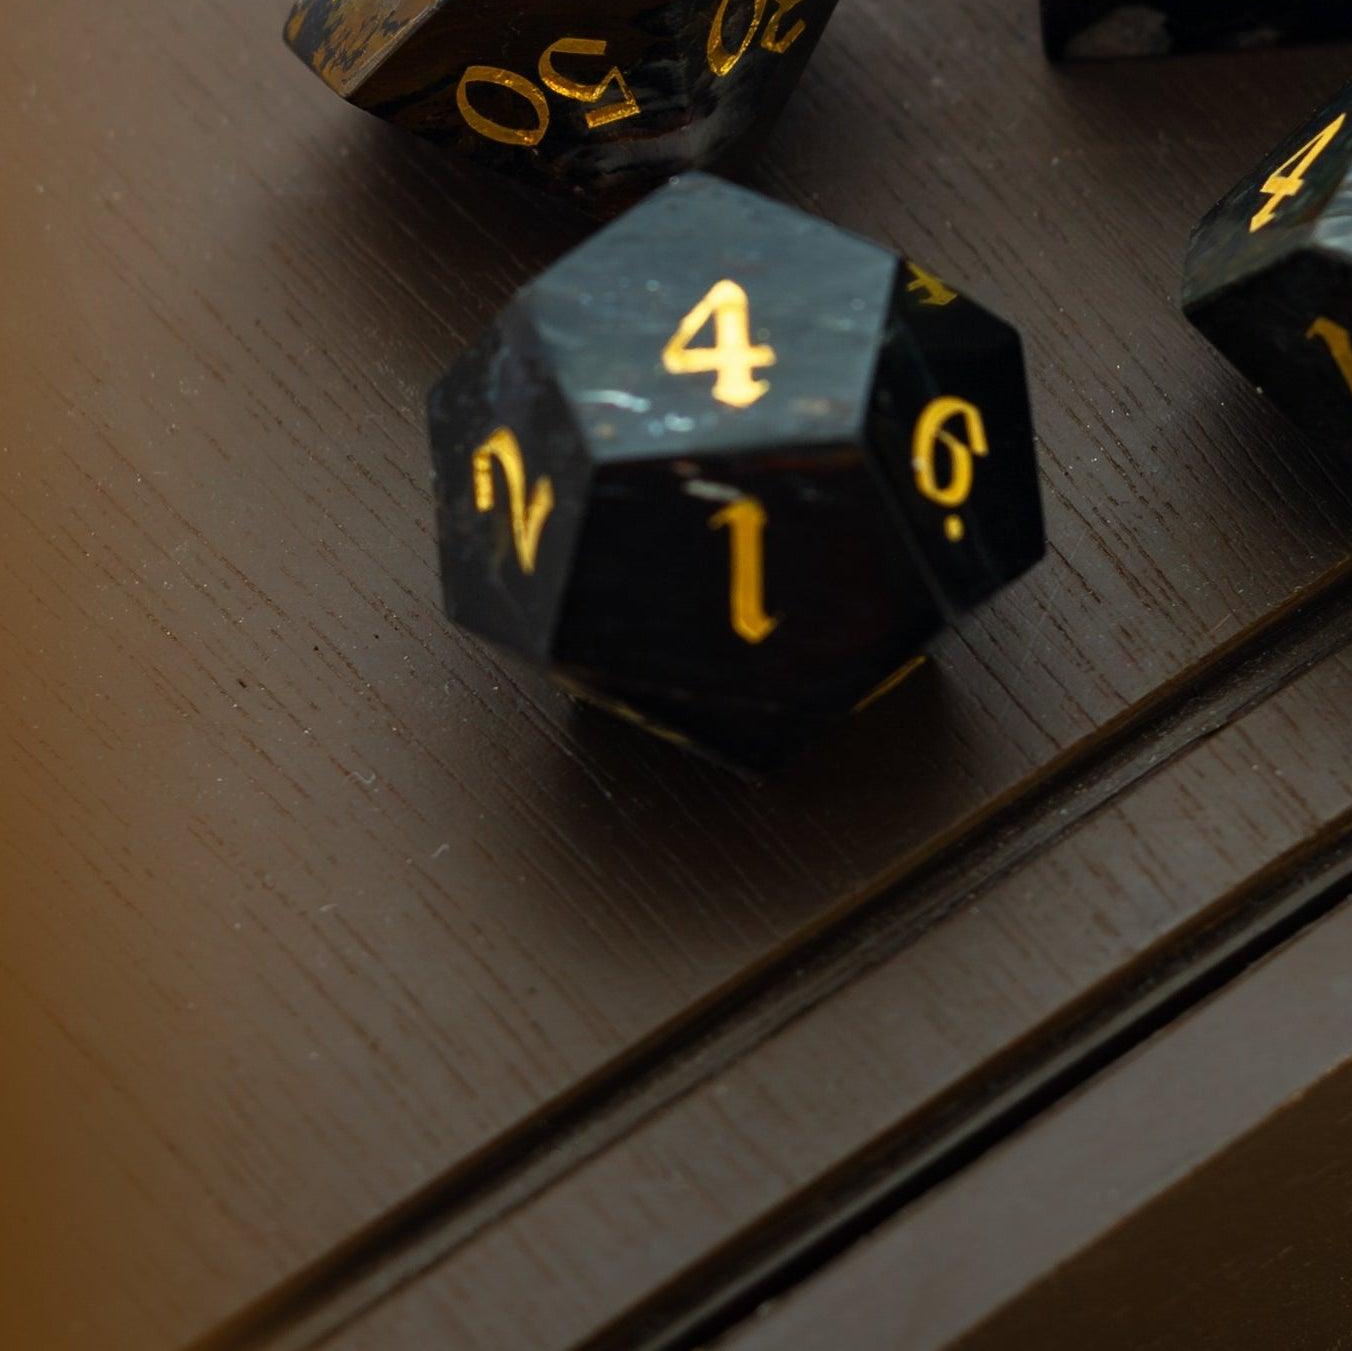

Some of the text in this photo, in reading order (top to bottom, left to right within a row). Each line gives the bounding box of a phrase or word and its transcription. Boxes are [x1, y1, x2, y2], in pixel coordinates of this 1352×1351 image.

[455, 36, 641, 147] 50
[1249, 113, 1346, 233] 4
[662, 278, 777, 409] 4
[471, 426, 555, 574] 2
[708, 496, 782, 646] 1
